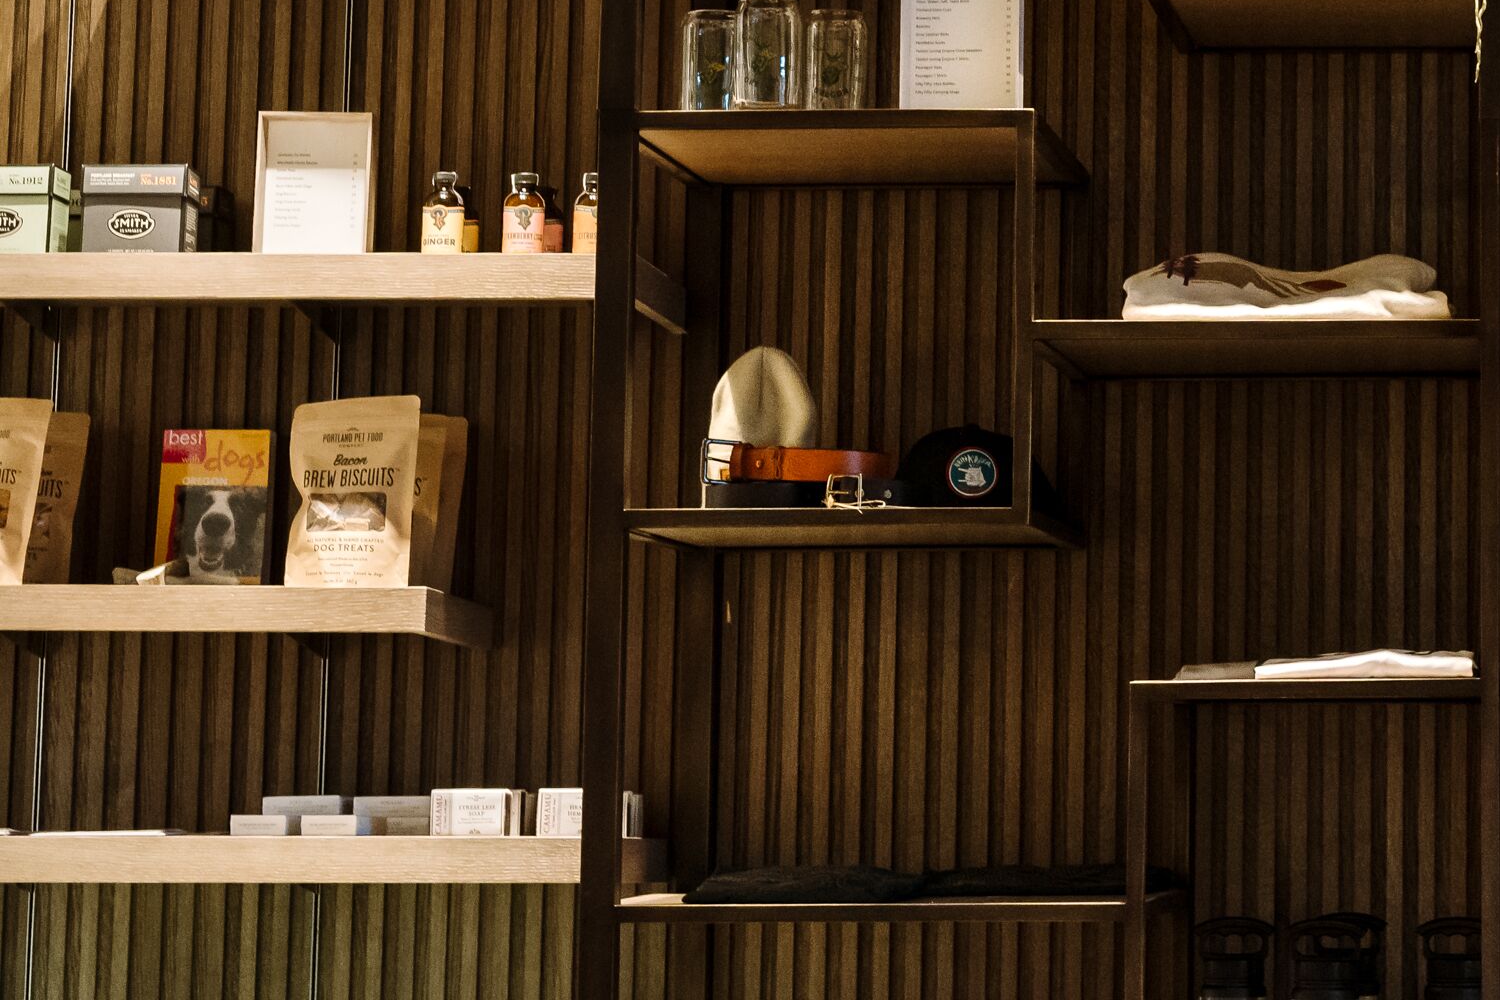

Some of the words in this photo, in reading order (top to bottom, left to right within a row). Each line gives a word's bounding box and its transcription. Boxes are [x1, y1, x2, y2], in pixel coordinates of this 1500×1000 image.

[113, 218, 149, 229] SMITH
[423, 238, 456, 247] GINGER
[169, 430, 204, 446] best
[322, 433, 353, 443] PORTLAND
[354, 433, 366, 442] PET
[367, 432, 384, 442] FOOD
[182, 454, 201, 463] with
[333, 454, 368, 466] Bacon
[203, 440, 266, 491] dogs
[303, 469, 336, 488] BREW
[340, 467, 395, 487] BISCUITS
[313, 543, 335, 552] DOG
[338, 543, 375, 553] TREATS
